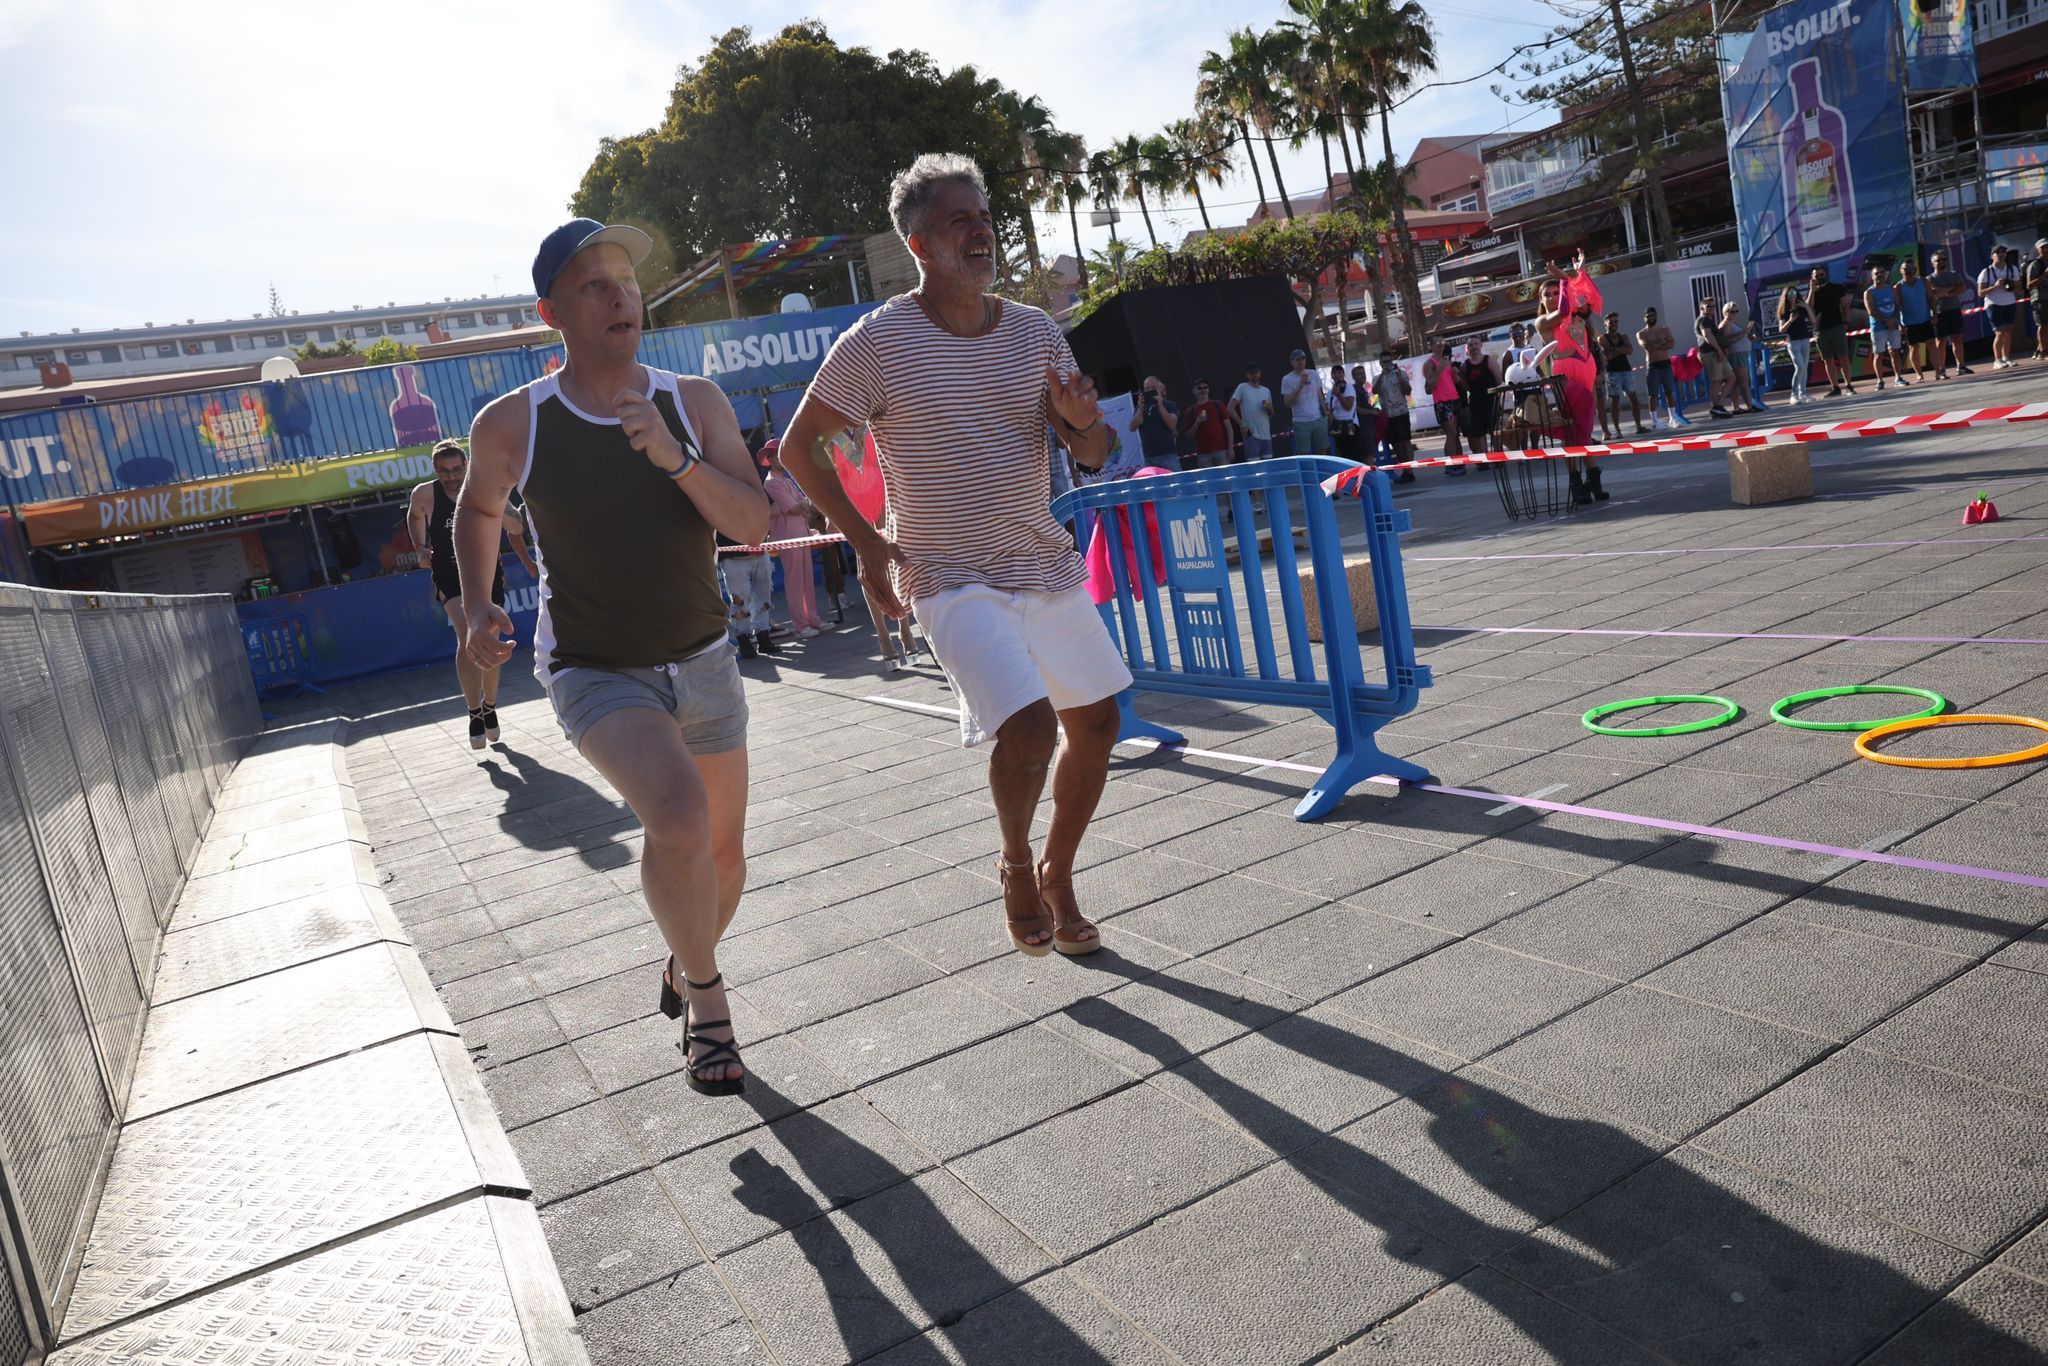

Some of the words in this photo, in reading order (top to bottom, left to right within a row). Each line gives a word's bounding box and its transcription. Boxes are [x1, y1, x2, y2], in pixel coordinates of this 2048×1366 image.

[1496, 137, 1538, 158] Skansen
[1510, 188, 1535, 201] COSMOS
[1471, 235, 1502, 251] COSMOS
[703, 326, 834, 377] ABSOLUT
[345, 454, 435, 489] PROUD
[99, 492, 174, 530] DRINK
[180, 484, 238, 518] HERE
[1177, 560, 1215, 570] MASPALOMAS
